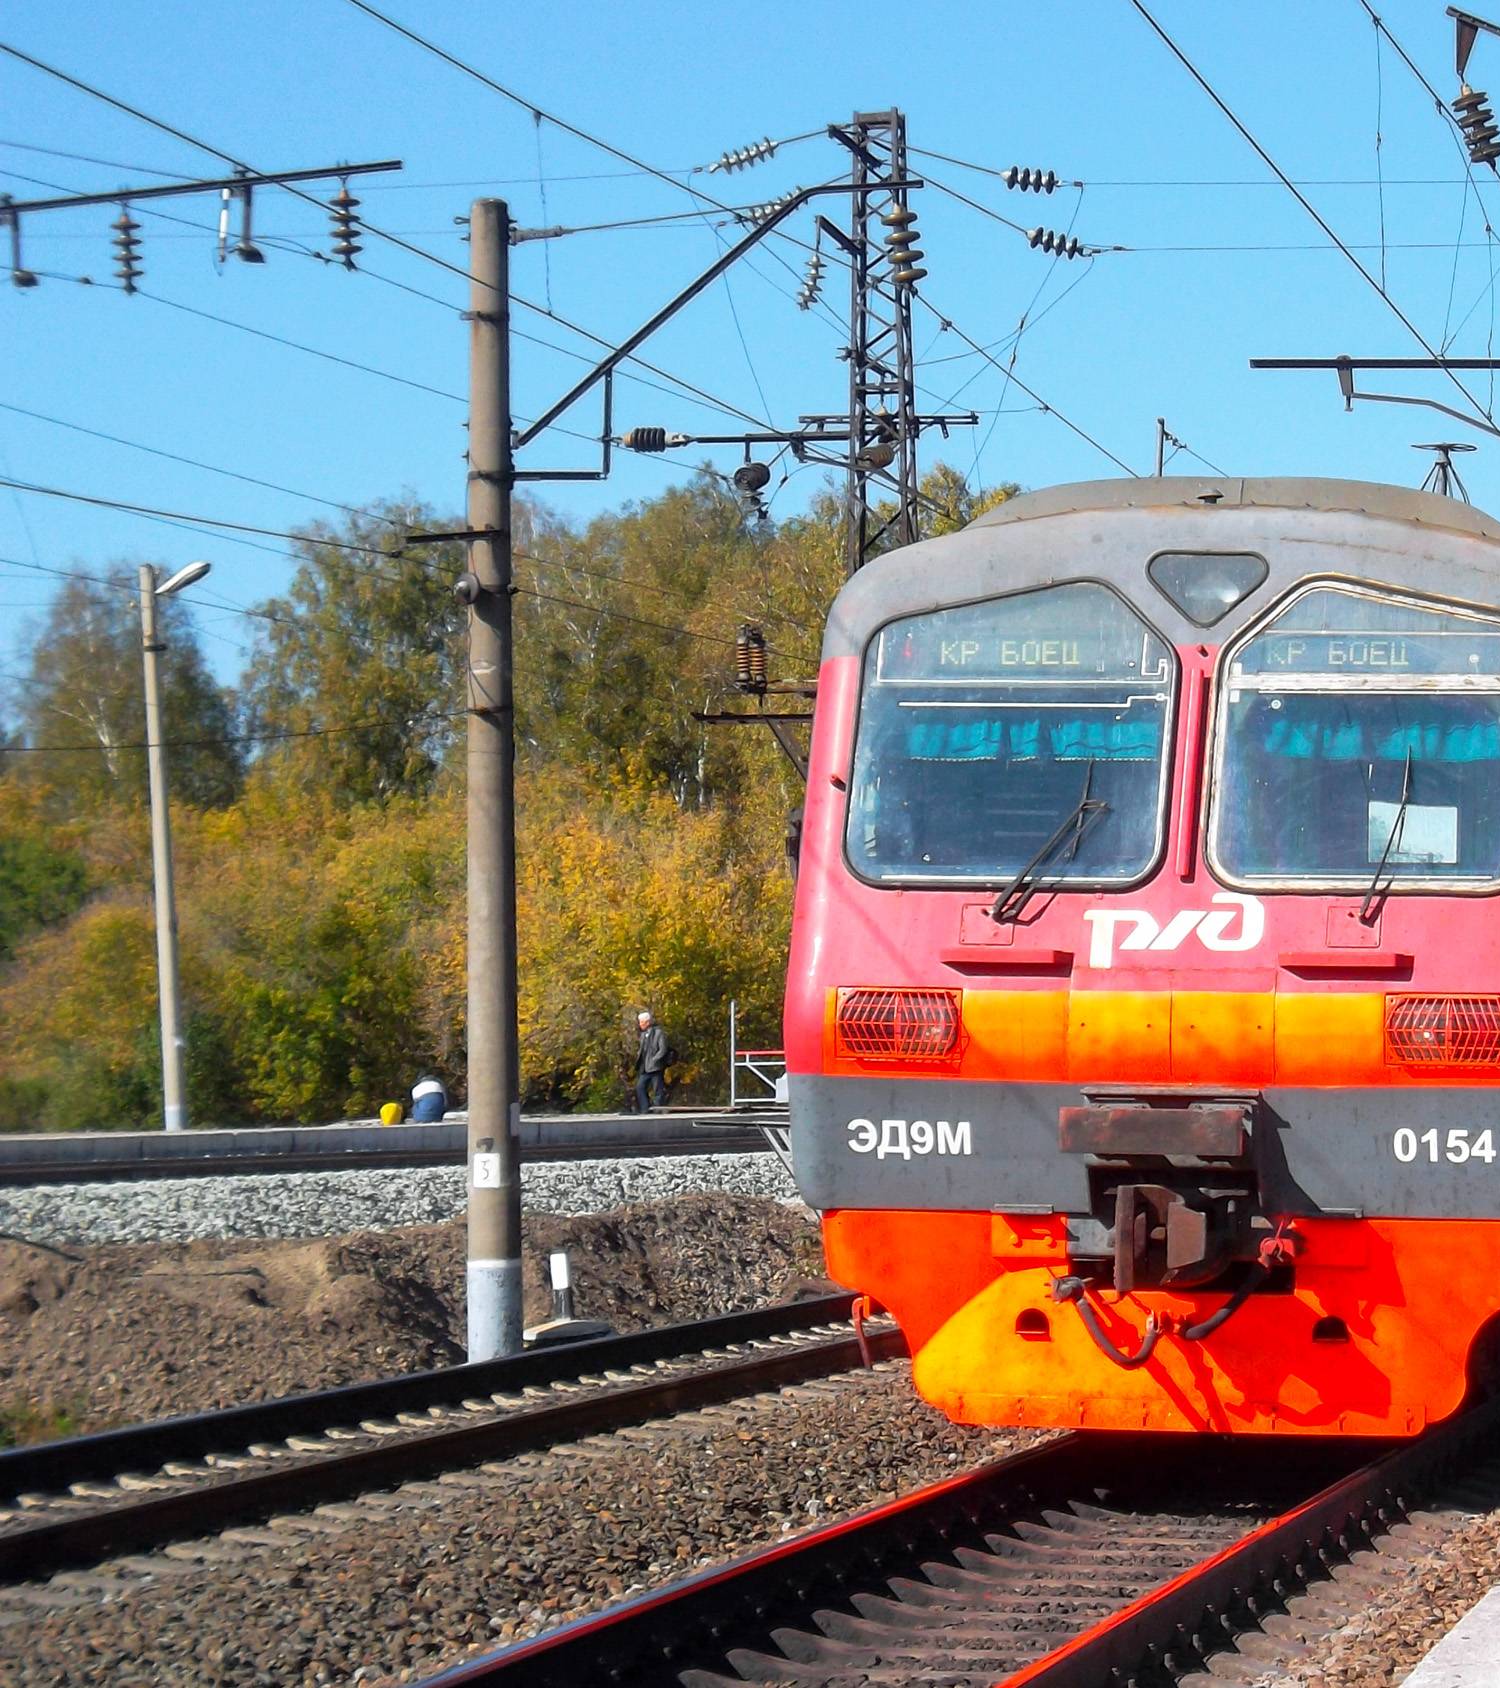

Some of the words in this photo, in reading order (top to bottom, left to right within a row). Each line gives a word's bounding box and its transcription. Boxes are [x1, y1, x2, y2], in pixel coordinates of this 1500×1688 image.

[940, 640, 979, 666] КР
[1001, 639, 1080, 666] БОЕЦ
[1328, 640, 1408, 666] БОЕЦ
[847, 1118, 972, 1160] ЭД9М
[1393, 1127, 1497, 1164] 0154
